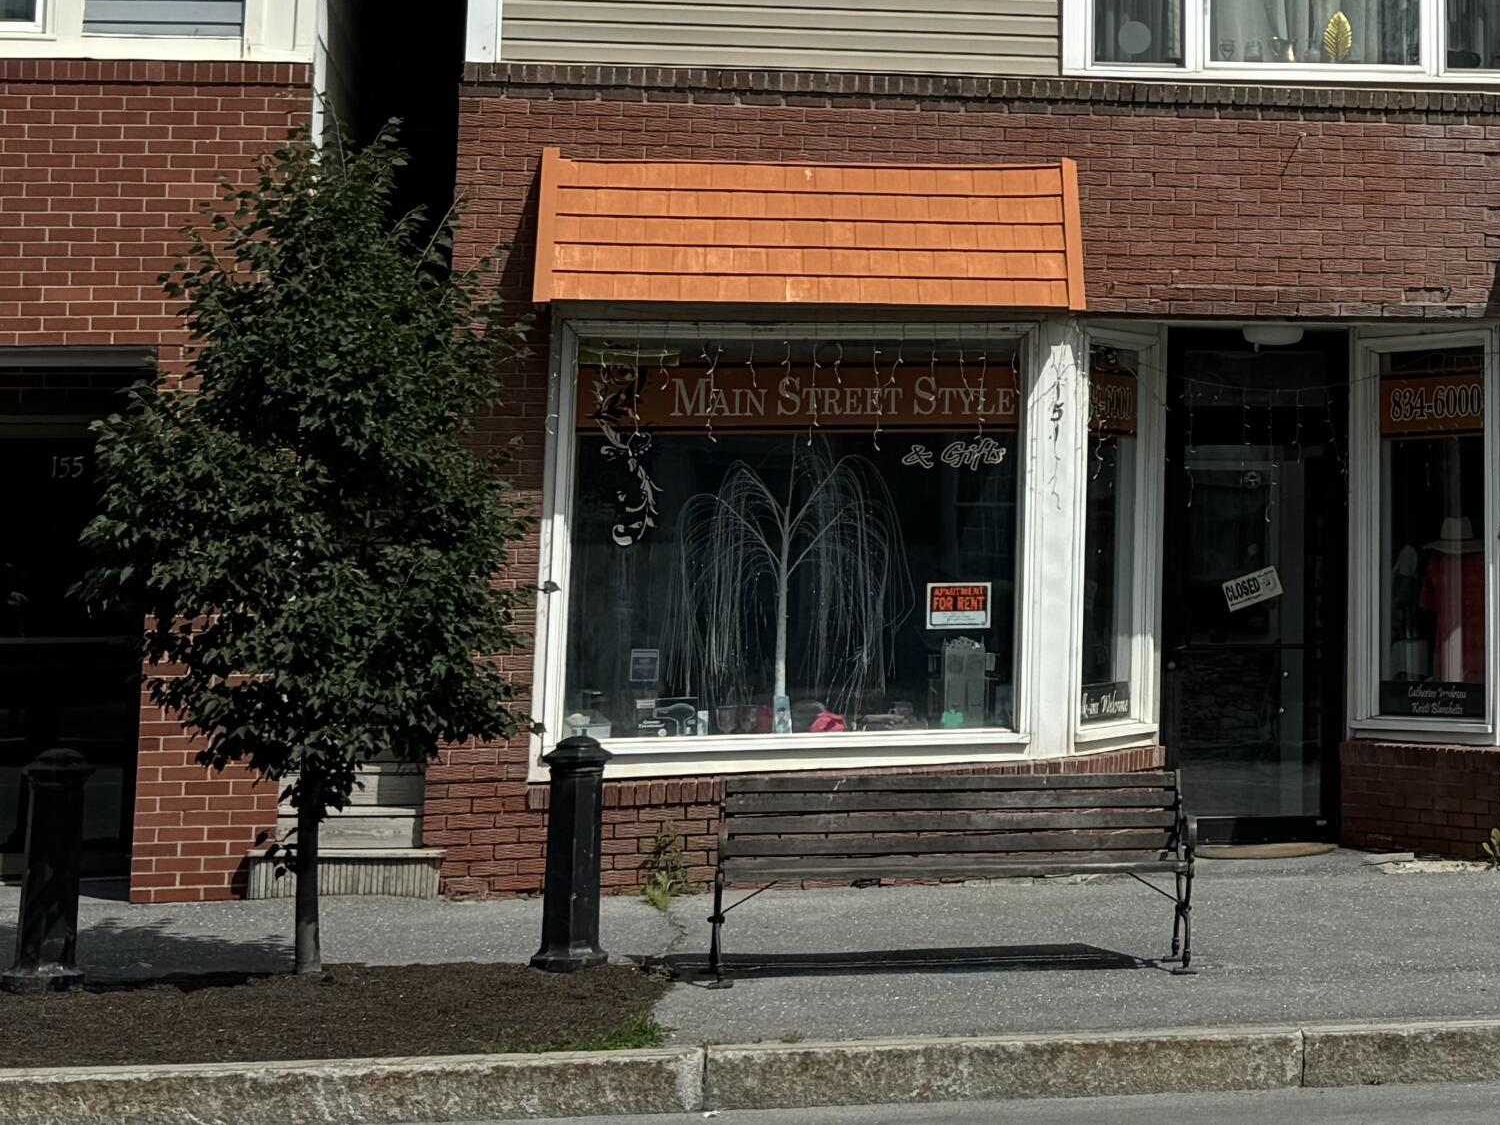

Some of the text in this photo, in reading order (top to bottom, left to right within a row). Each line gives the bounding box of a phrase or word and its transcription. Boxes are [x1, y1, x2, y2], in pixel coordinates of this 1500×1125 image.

[1391, 383, 1482, 421] 834-6000
[902, 437, 1007, 471] & Gifts
[51, 455, 85, 479] 155
[933, 586, 985, 597] APARTMENT
[1225, 576, 1261, 603] CLOSED
[932, 596, 985, 611] FOR RENT
